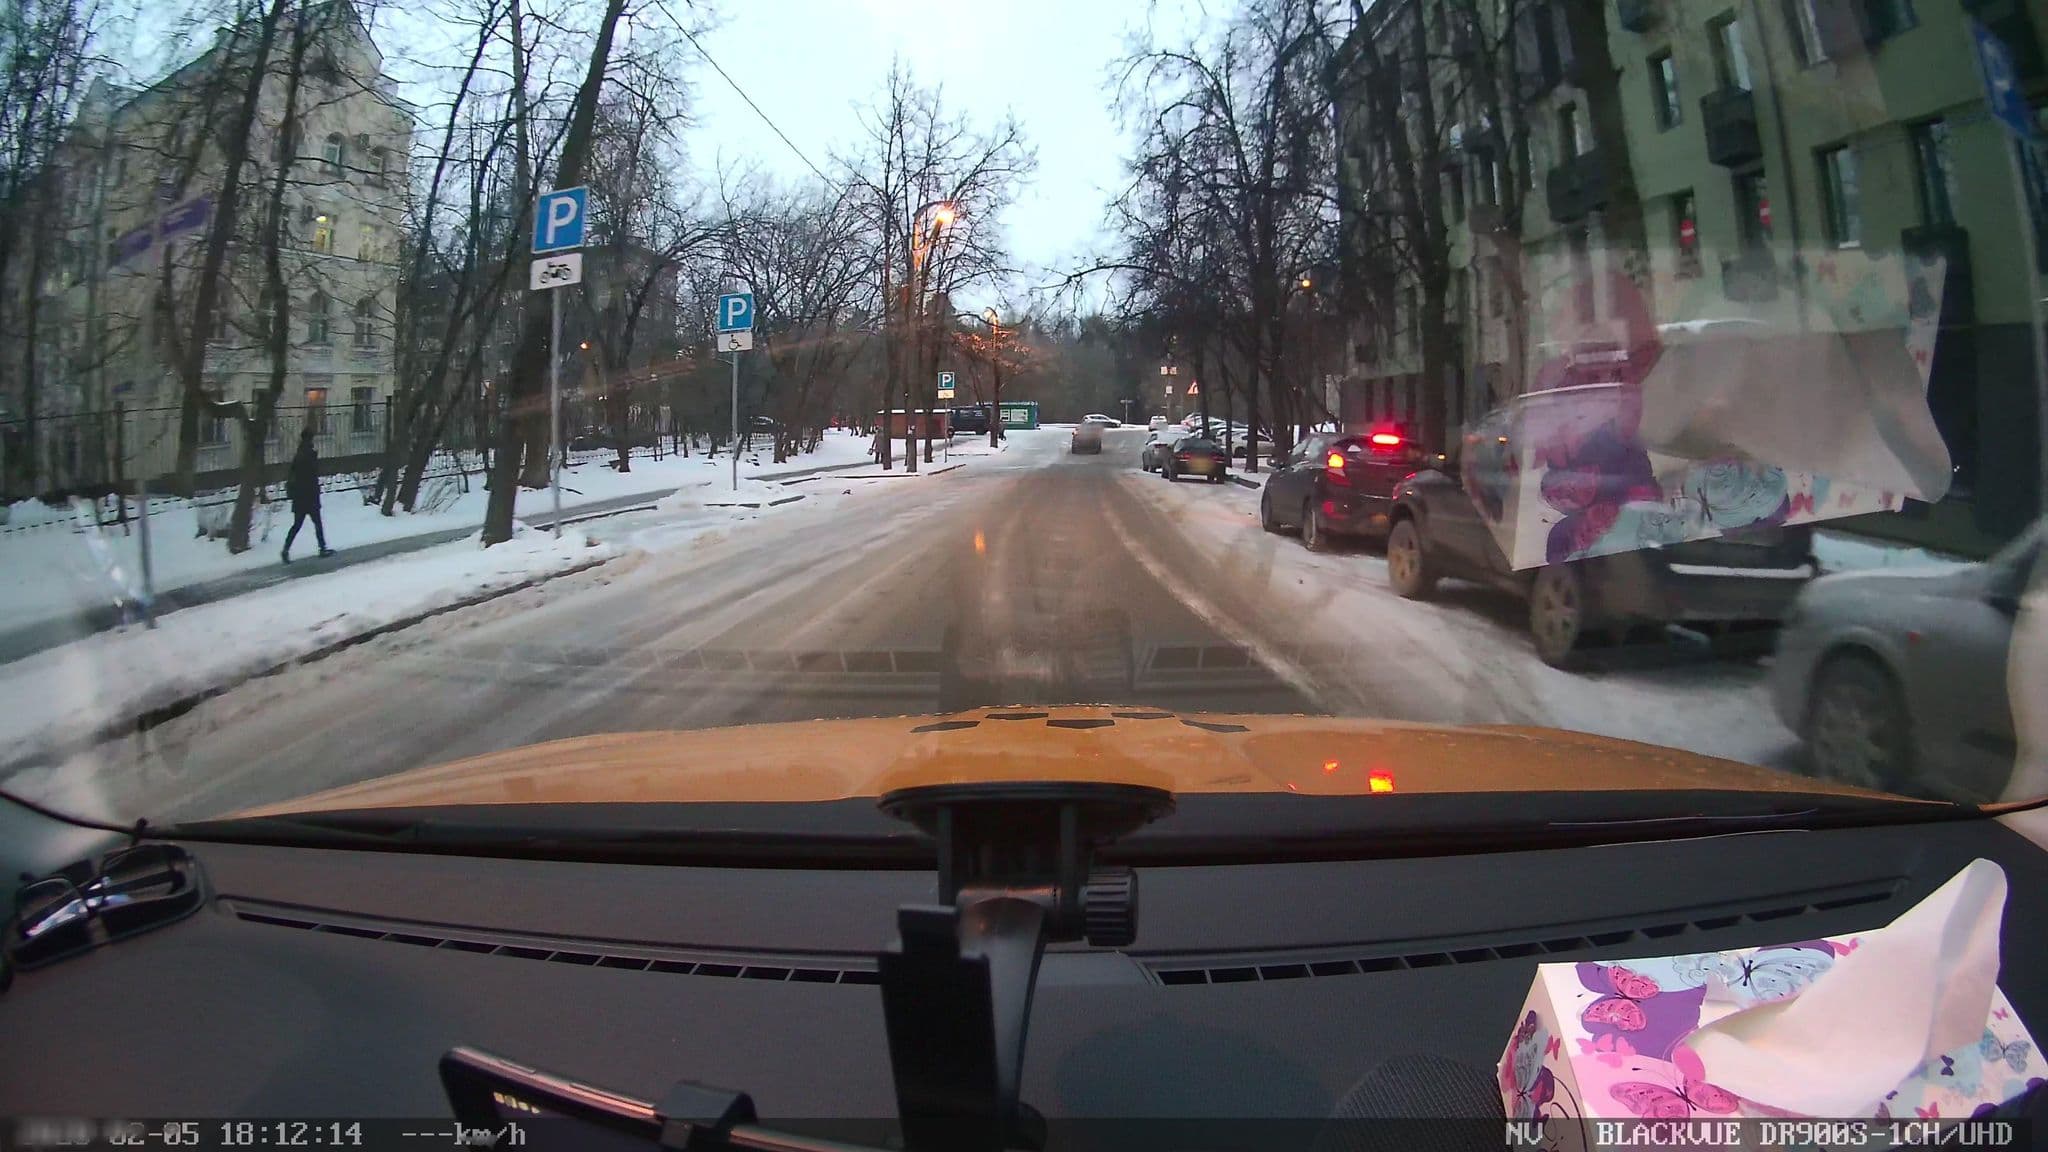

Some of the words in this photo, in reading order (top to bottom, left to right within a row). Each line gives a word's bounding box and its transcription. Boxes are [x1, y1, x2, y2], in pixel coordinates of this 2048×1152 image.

[546, 196, 578, 244] P
[726, 297, 748, 326] P
[942, 374, 952, 387] P
